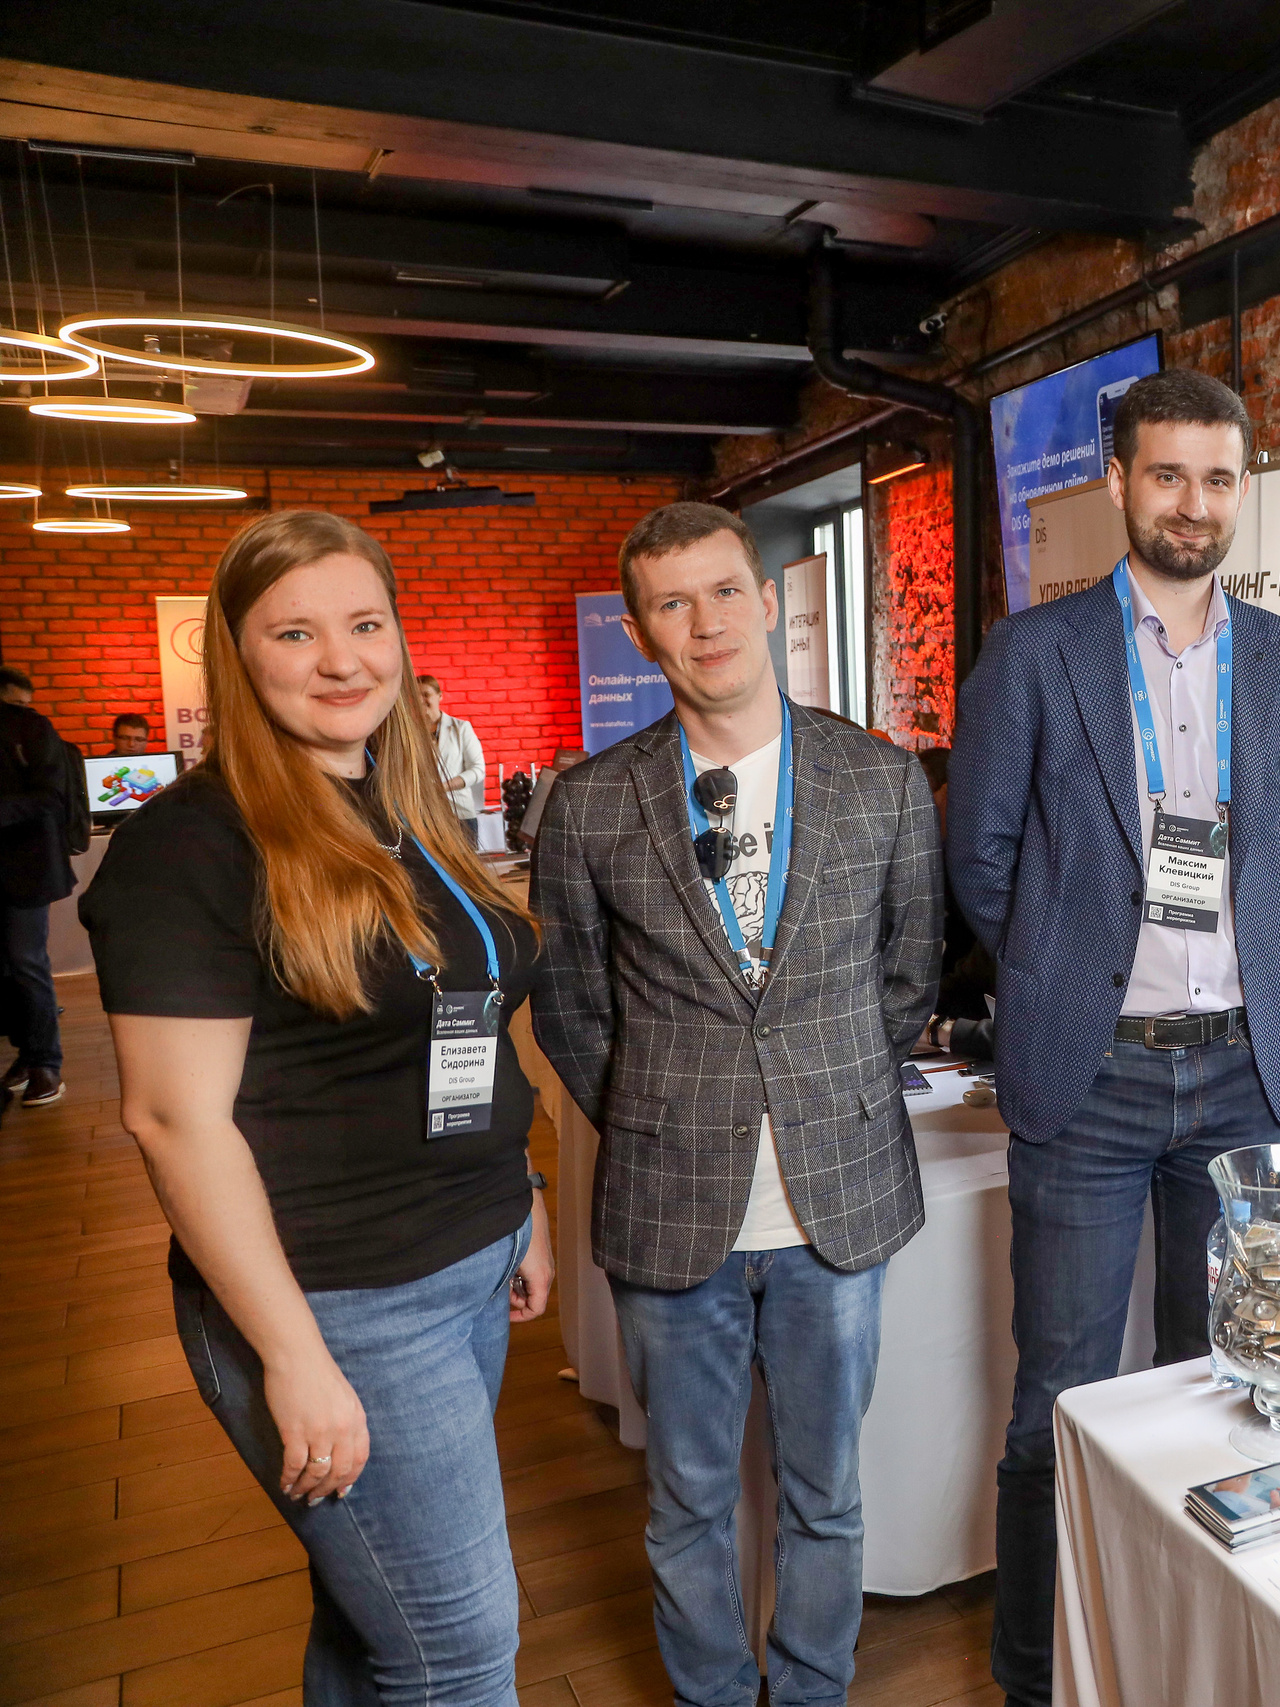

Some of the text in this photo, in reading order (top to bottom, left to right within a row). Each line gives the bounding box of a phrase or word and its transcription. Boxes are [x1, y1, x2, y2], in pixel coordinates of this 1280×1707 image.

[1042, 452, 1060, 468] демо
[1061, 438, 1095, 466] решений
[1036, 527, 1046, 544] DIS
[588, 692, 632, 704] данных
[1158, 834, 1200, 846] Дата Саммит
[1168, 856, 1207, 870] Максим
[1159, 865, 1214, 880] Клевицкий
[1182, 884, 1200, 892] Group
[1162, 894, 1206, 905] ОРГАНИЗАТОР
[436, 1018, 476, 1028] Дата Саммит
[441, 1046, 486, 1056] Елизавета
[441, 1058, 484, 1070] Сидорина
[458, 1076, 475, 1084] Group
[442, 1092, 480, 1102] ОРГАНИЗАТОР
